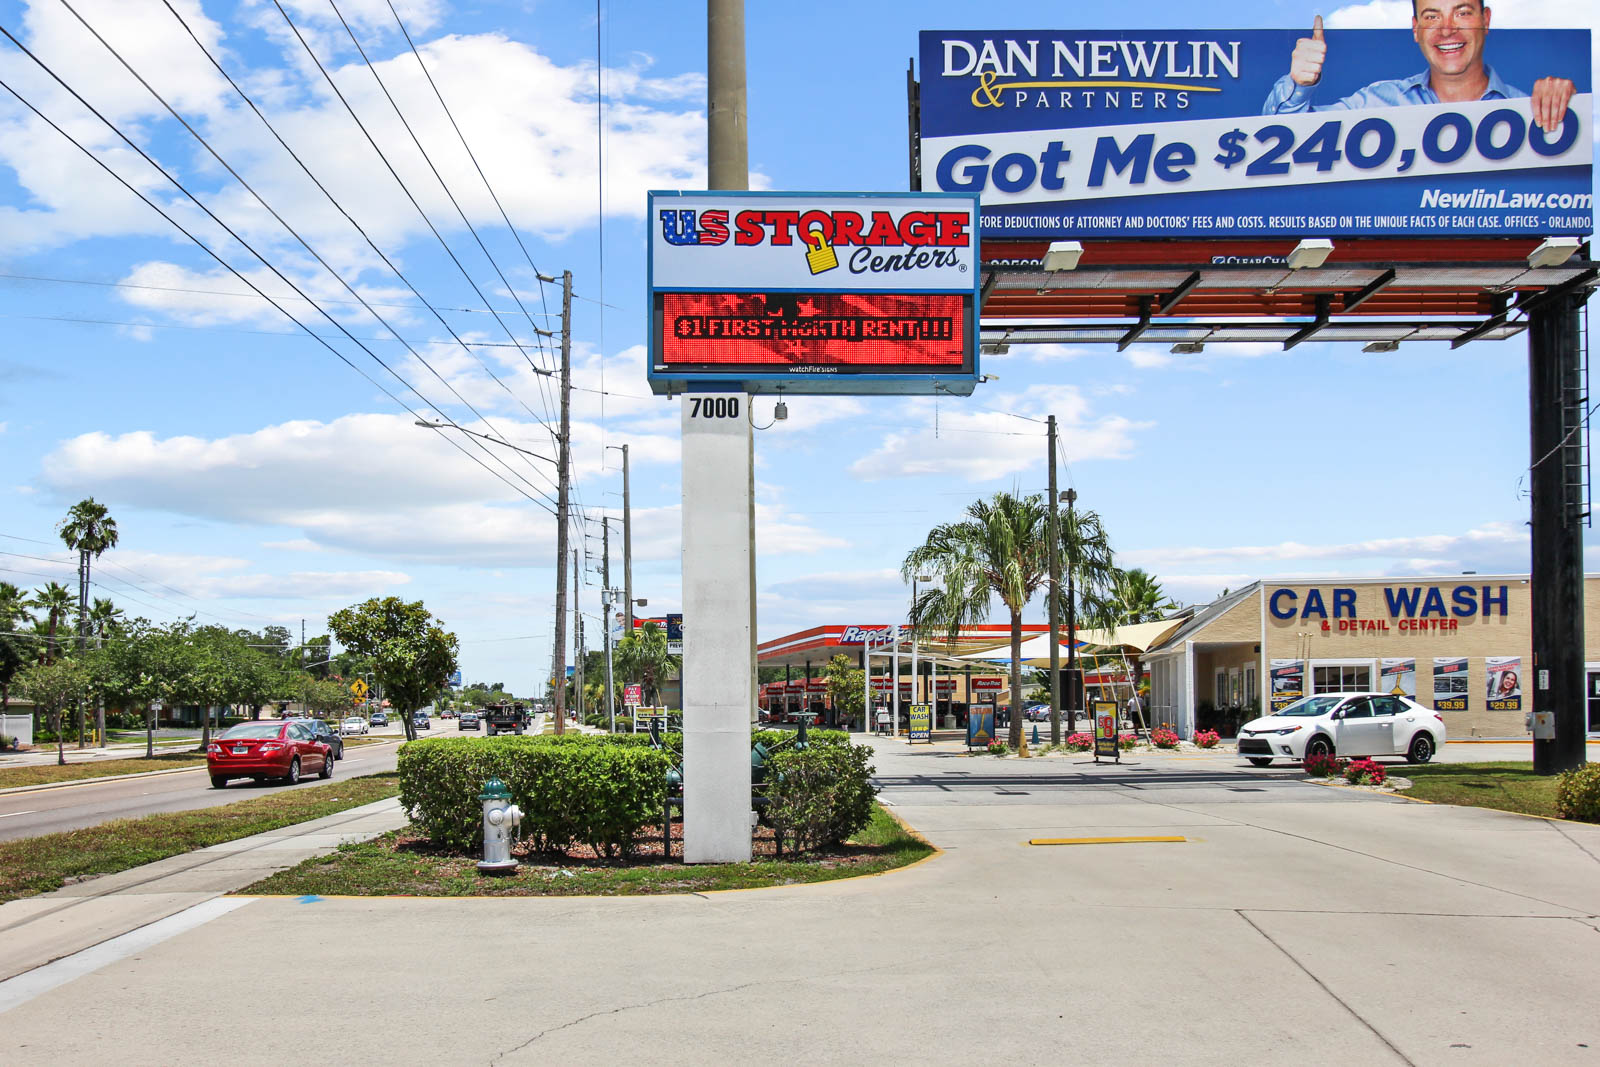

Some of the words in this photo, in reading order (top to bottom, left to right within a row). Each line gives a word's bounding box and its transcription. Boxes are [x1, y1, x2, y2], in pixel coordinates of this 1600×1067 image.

[941, 40, 1039, 77] DAN
[1052, 40, 1241, 78] NEWLIN
[971, 70, 1005, 108] &
[1015, 91, 1189, 108] PARTNERS
[935, 141, 1072, 193] Got
[1087, 133, 1197, 187] Me
[1214, 108, 1580, 177] $240,000
[1420, 189, 1592, 209] NewlinLaw.com
[660, 209, 730, 246] US
[734, 209, 970, 247] STORAGE
[1004, 216, 1060, 228] DEDUCTIONS
[1063, 216, 1075, 228] OF
[1077, 216, 1122, 228] ATTORNEY
[1125, 216, 1144, 228] AND
[1192, 216, 1212, 228] FEES
[1215, 216, 1234, 228] AND
[1237, 216, 1266, 228] COSTS.
[1269, 216, 1306, 228] RESULTS
[1309, 216, 1337, 228] BASED
[1339, 216, 1353, 228] ON
[1355, 216, 1372, 228] THE
[1374, 216, 1408, 228] UNIQUE
[1411, 216, 1435, 228] FACTS
[1438, 216, 1450, 228] OF
[1452, 215, 1475, 228] EACH
[1478, 216, 1502, 228] CASE.
[1504, 216, 1539, 228] OFFICES
[1548, 216, 1592, 228] ORLANDO.
[849, 245, 960, 275] Centers
[708, 319, 774, 336] FIRST
[690, 397, 739, 419] 7000
[1269, 588, 1358, 619] CAR
[1384, 585, 1508, 618] WASH
[1321, 620, 1331, 631] &
[1339, 619, 1389, 631] DETAIL
[1399, 618, 1458, 630] CENTER
